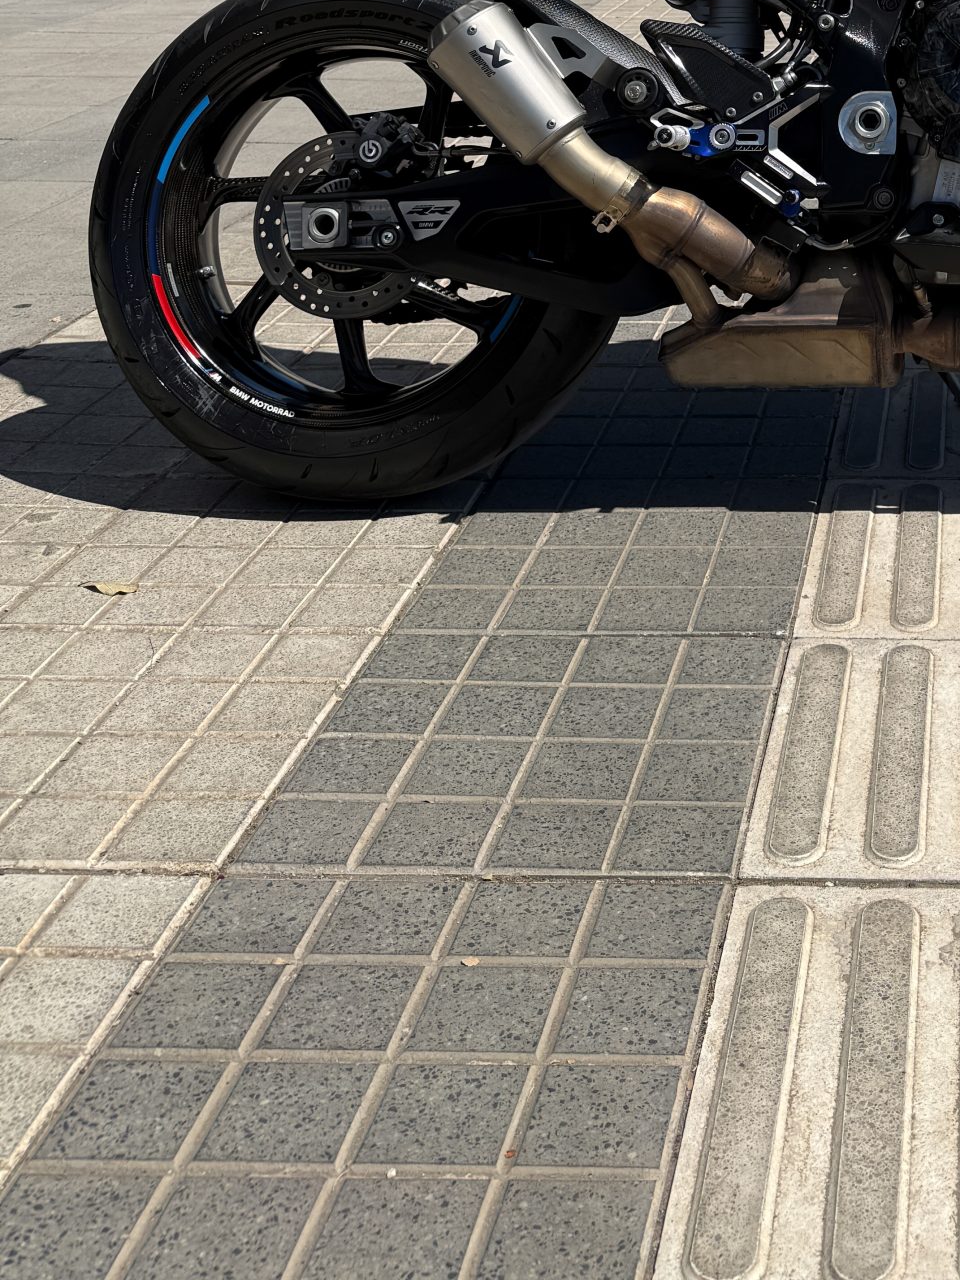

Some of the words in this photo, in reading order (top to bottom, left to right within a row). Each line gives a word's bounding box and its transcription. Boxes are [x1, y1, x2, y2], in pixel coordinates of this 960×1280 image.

[274, 7, 415, 30] Roadsport
[229, 386, 250, 401] BMW
[249, 397, 295, 418] MOTORRAD
